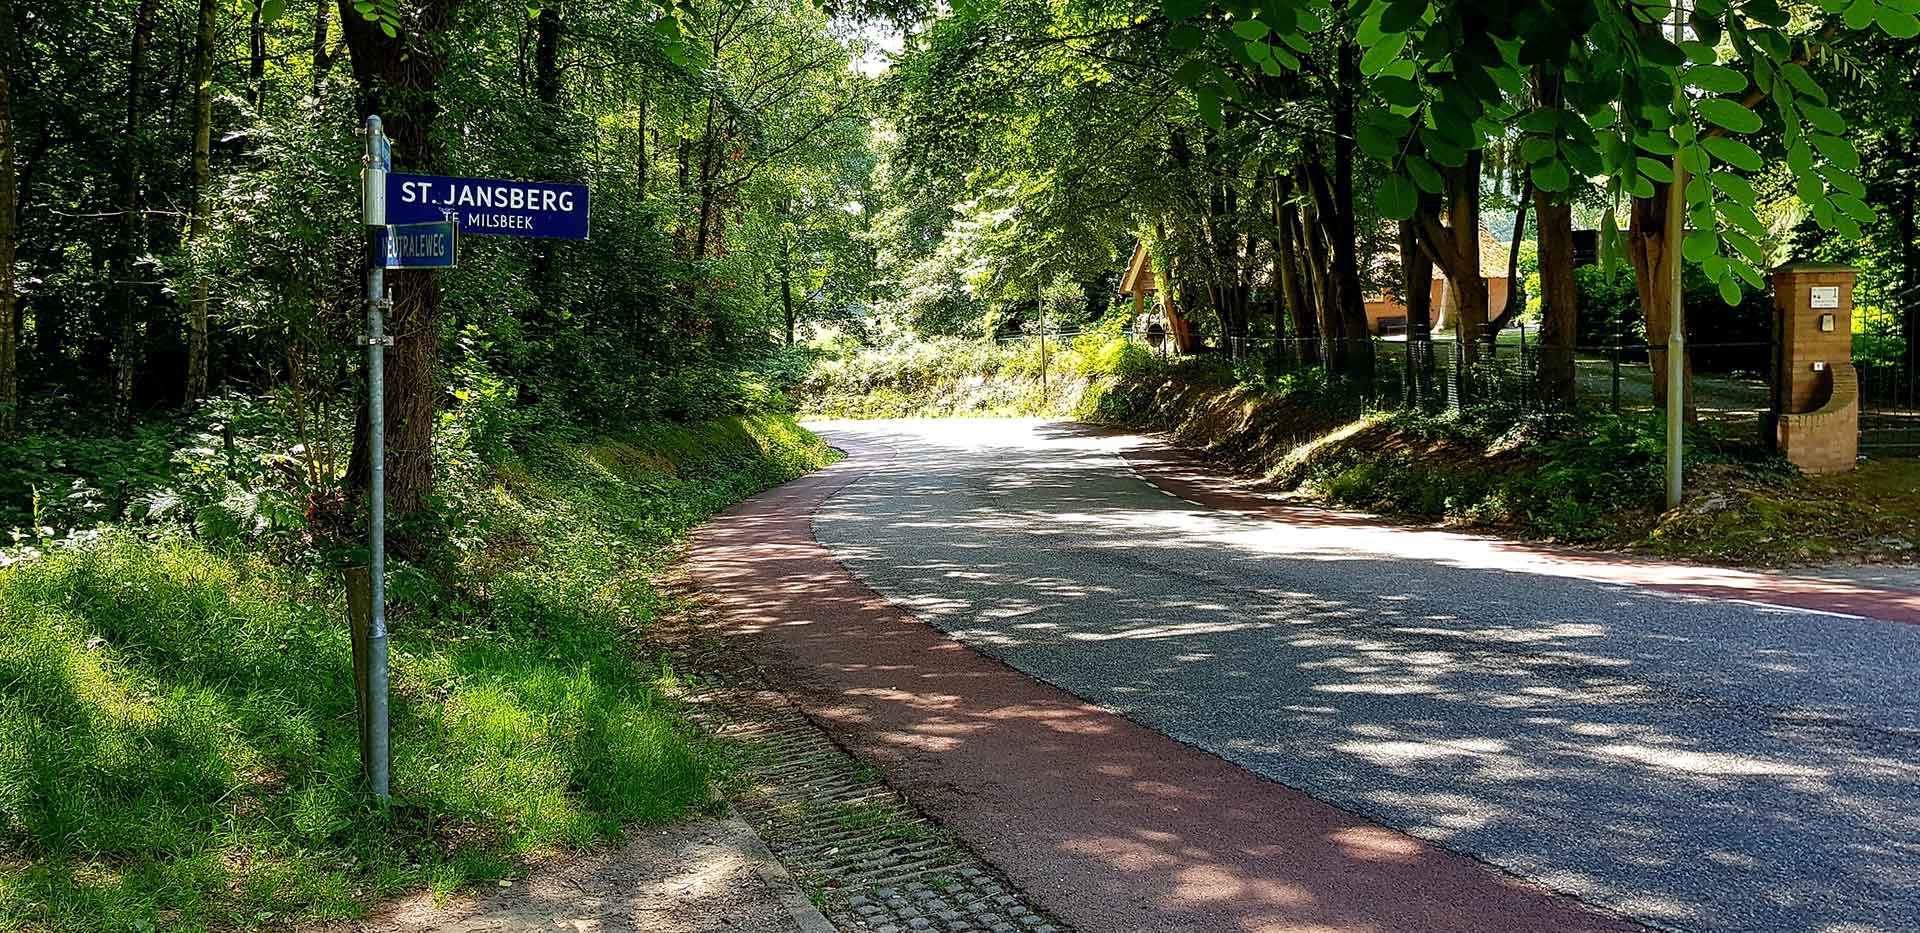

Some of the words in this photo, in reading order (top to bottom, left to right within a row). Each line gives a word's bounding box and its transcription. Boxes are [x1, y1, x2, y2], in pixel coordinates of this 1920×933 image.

[401, 181, 437, 204] ST.
[443, 184, 574, 212] JANSBERG
[468, 214, 534, 230] MILSBEEK
